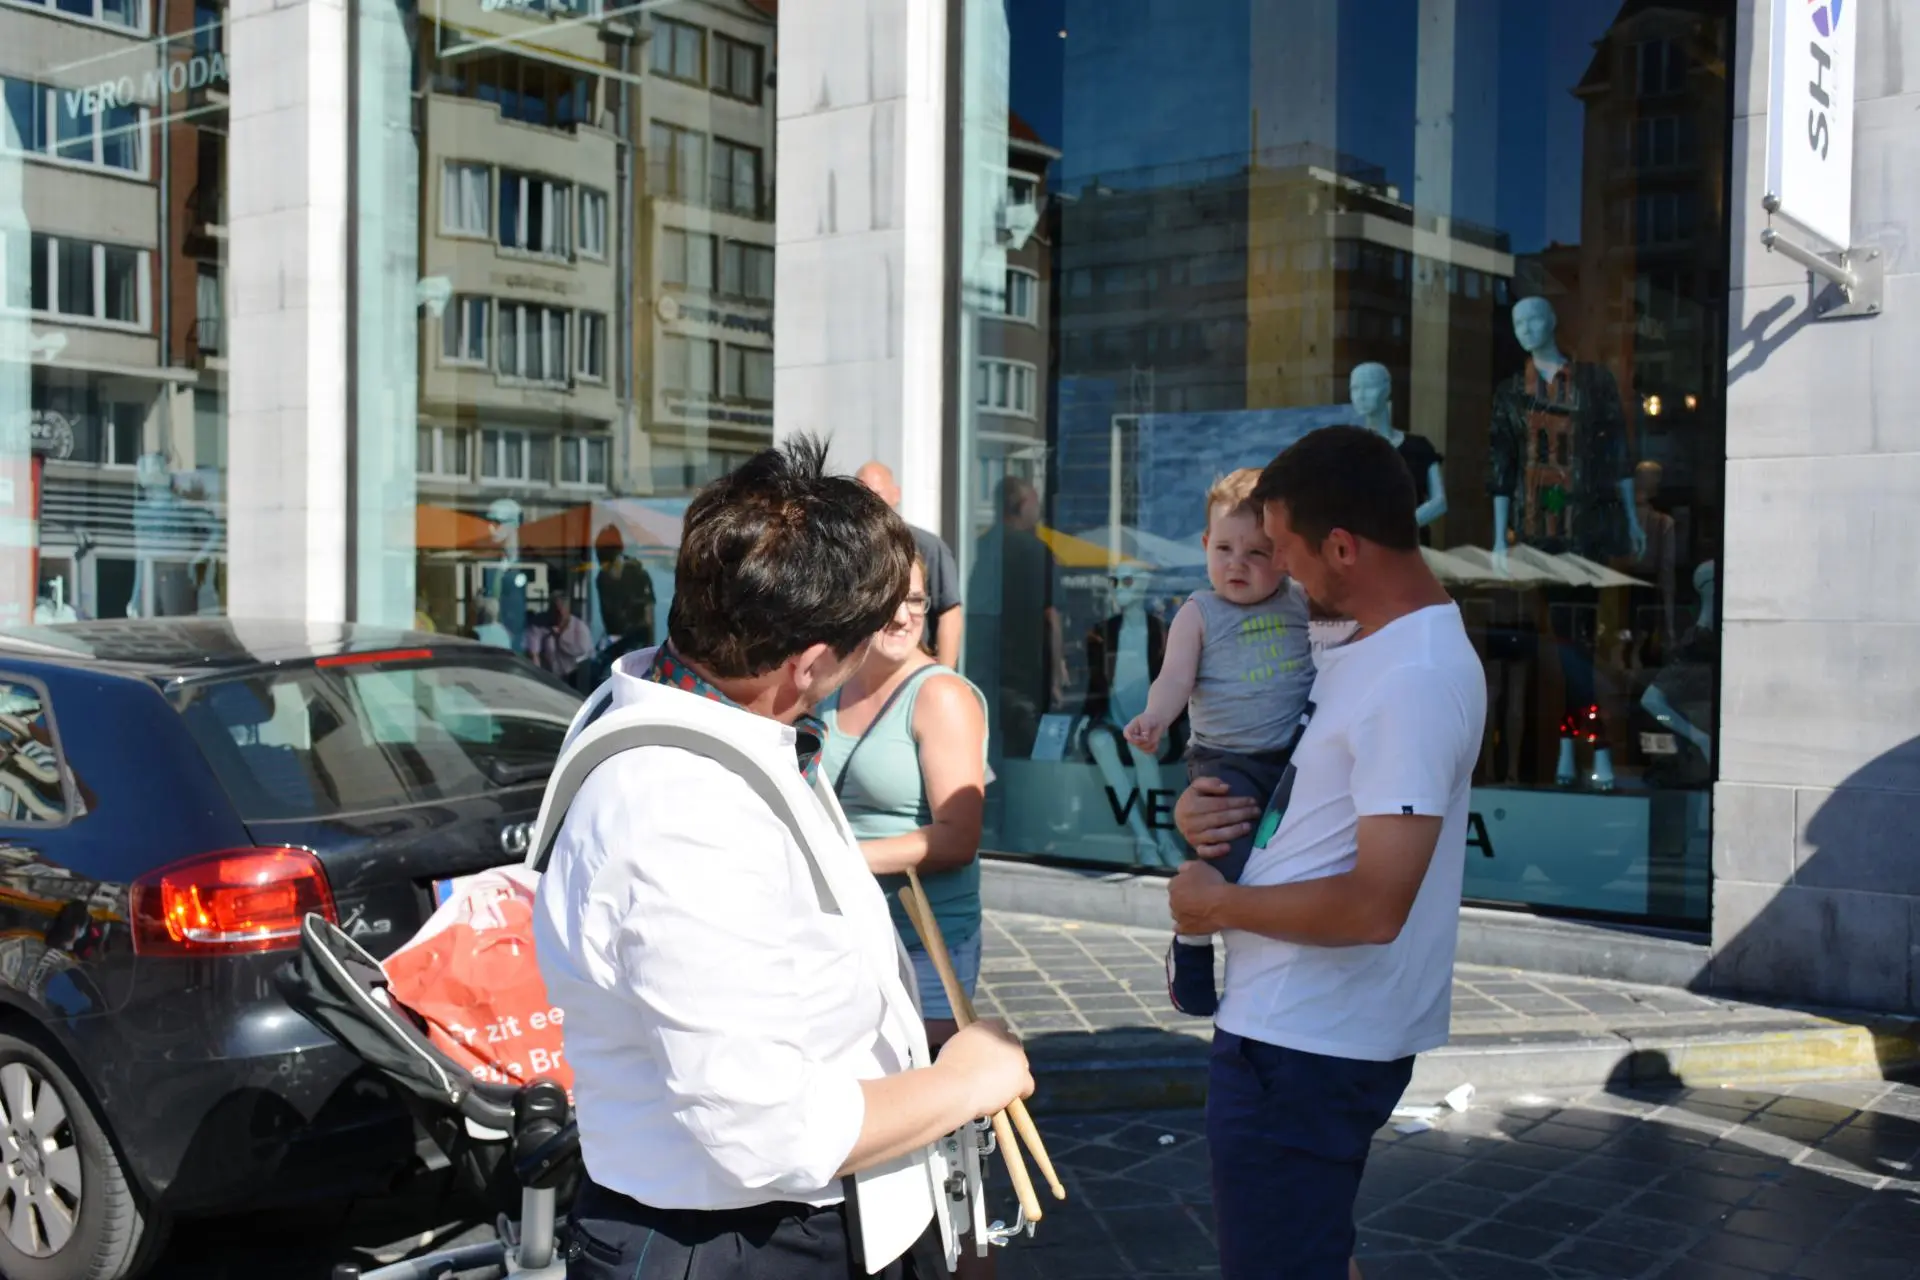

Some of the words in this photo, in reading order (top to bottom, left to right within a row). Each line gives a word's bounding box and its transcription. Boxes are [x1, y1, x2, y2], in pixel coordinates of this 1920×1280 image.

[65, 75, 134, 120] VERO
[142, 51, 228, 101] MODA
[351, 918, 391, 938] A3
[485, 1015, 522, 1043] zit
